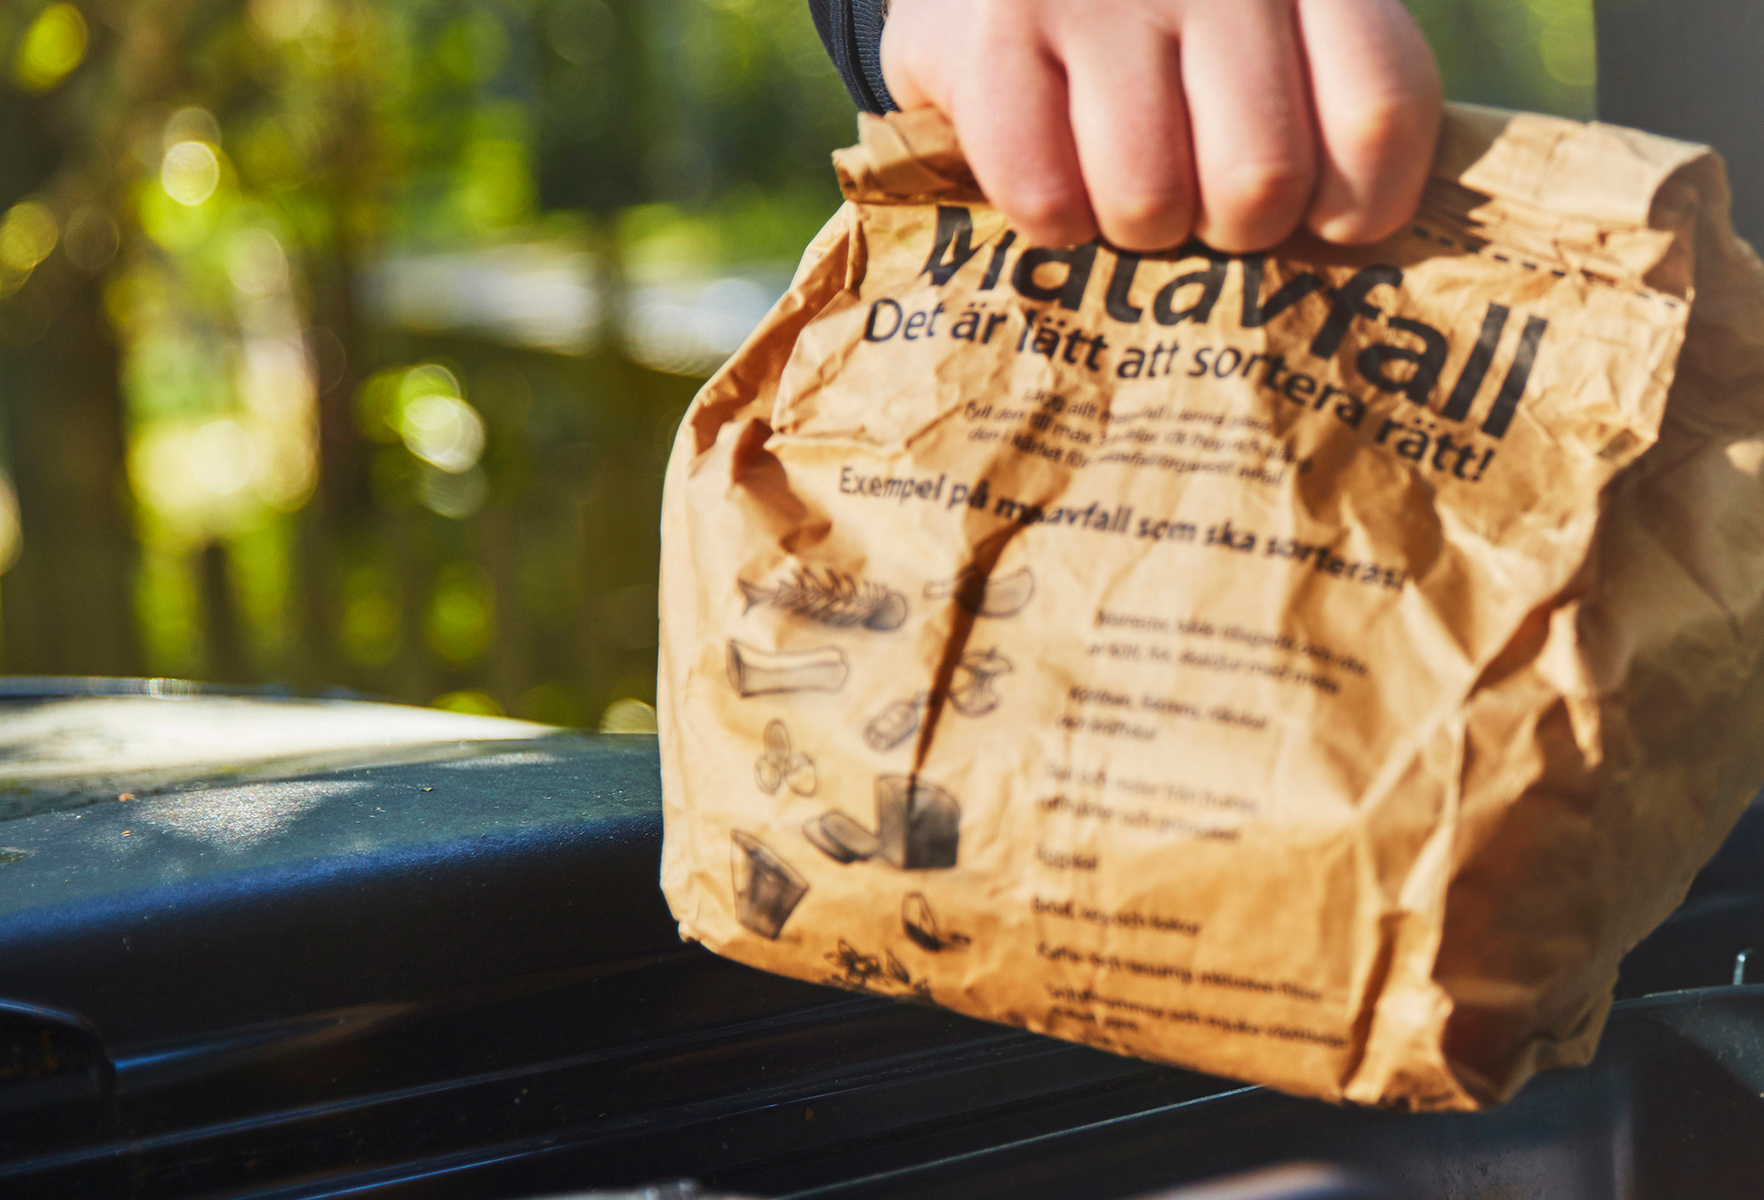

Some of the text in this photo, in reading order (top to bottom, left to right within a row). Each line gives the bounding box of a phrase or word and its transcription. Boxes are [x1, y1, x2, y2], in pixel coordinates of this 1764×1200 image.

[863, 297, 1496, 483] Det är lätt att sortera rätt!
[917, 205, 1548, 439] Matavfall
[839, 465, 945, 504] Exempel
[946, 478, 992, 511] på
[995, 495, 1133, 532] mavfall
[1137, 515, 1197, 543] som
[1206, 518, 1257, 553] ska
